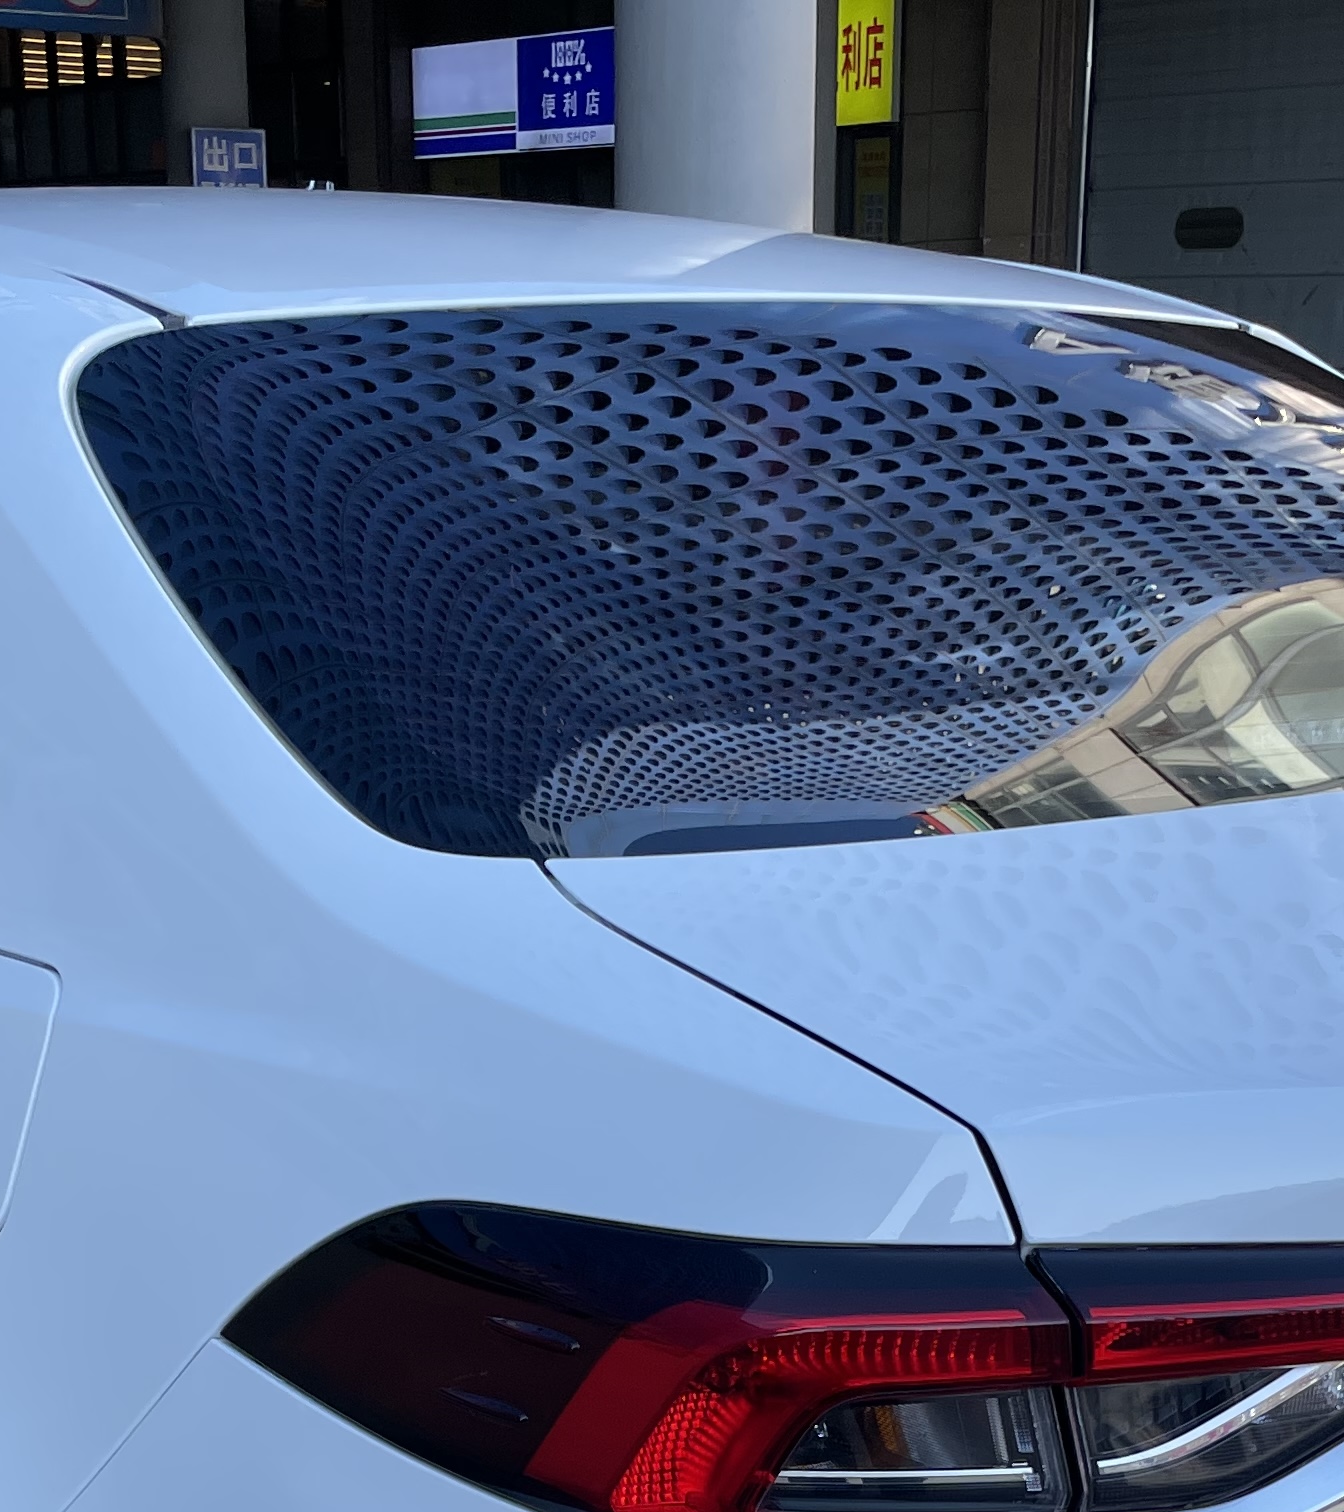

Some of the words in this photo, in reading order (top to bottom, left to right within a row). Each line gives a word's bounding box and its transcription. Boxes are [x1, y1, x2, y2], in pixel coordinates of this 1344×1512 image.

[541, 88, 600, 119] 便利店
[567, 130, 597, 143] SHOP
[203, 136, 257, 172] 出口
